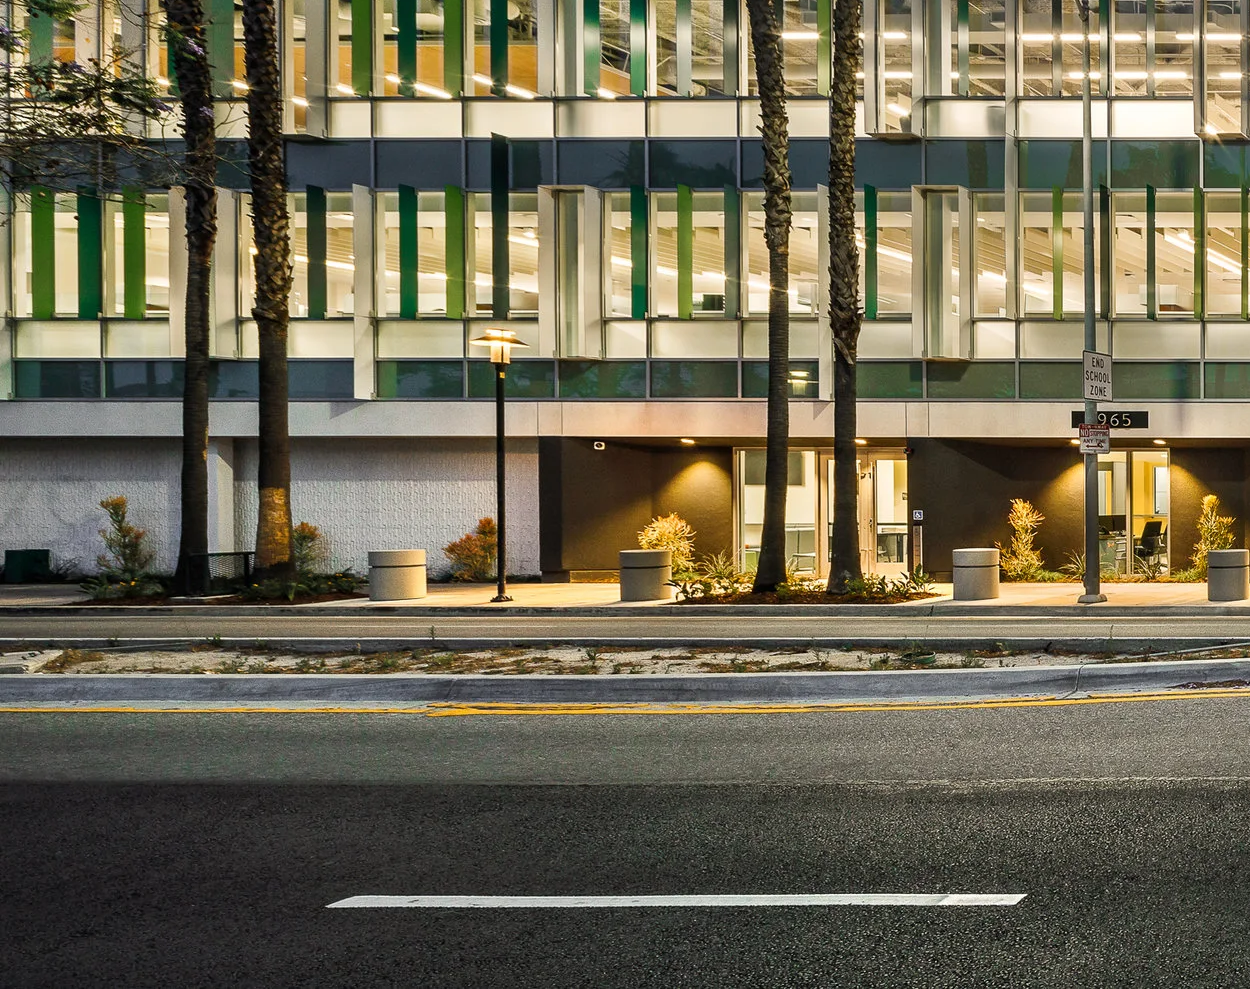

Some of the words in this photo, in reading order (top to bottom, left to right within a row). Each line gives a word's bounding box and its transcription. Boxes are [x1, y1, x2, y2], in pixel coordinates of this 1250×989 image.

[1091, 357, 1105, 369] END
[1085, 370, 1111, 384] SCHOOL
[1090, 385, 1107, 397] ZONE
[1097, 413, 1131, 427] 965
[1080, 429, 1089, 437] NO
